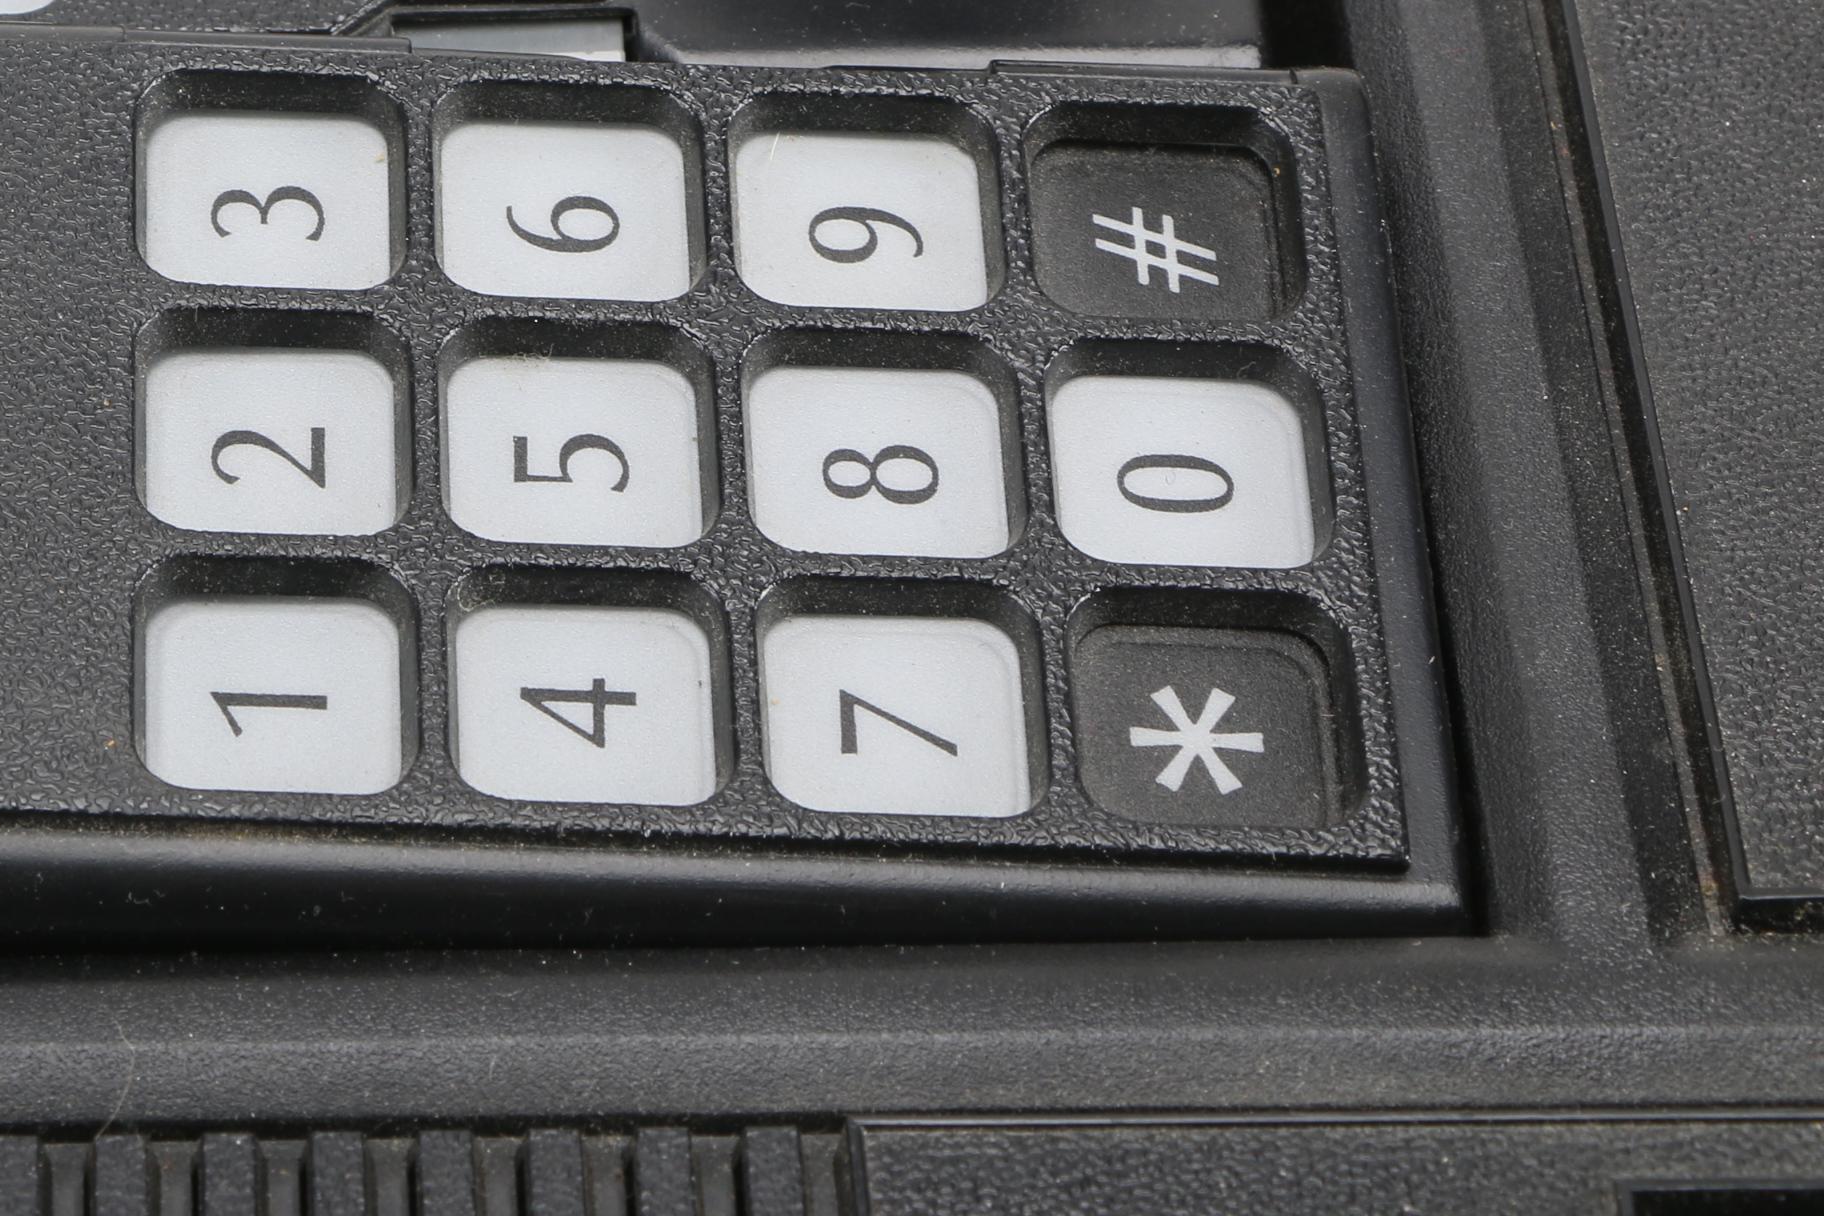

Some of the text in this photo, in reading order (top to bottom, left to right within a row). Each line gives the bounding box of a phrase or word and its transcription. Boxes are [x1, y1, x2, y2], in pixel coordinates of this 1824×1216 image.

[211, 186, 325, 241] 3
[507, 196, 620, 253] 6
[808, 207, 923, 263] 9
[1093, 207, 1219, 293] #
[211, 427, 325, 488] 2
[513, 434, 629, 492] 5
[822, 445, 939, 504] 8
[1117, 454, 1234, 513] 0
[210, 692, 327, 737] 1
[520, 678, 636, 748] 4
[839, 690, 957, 756] 7
